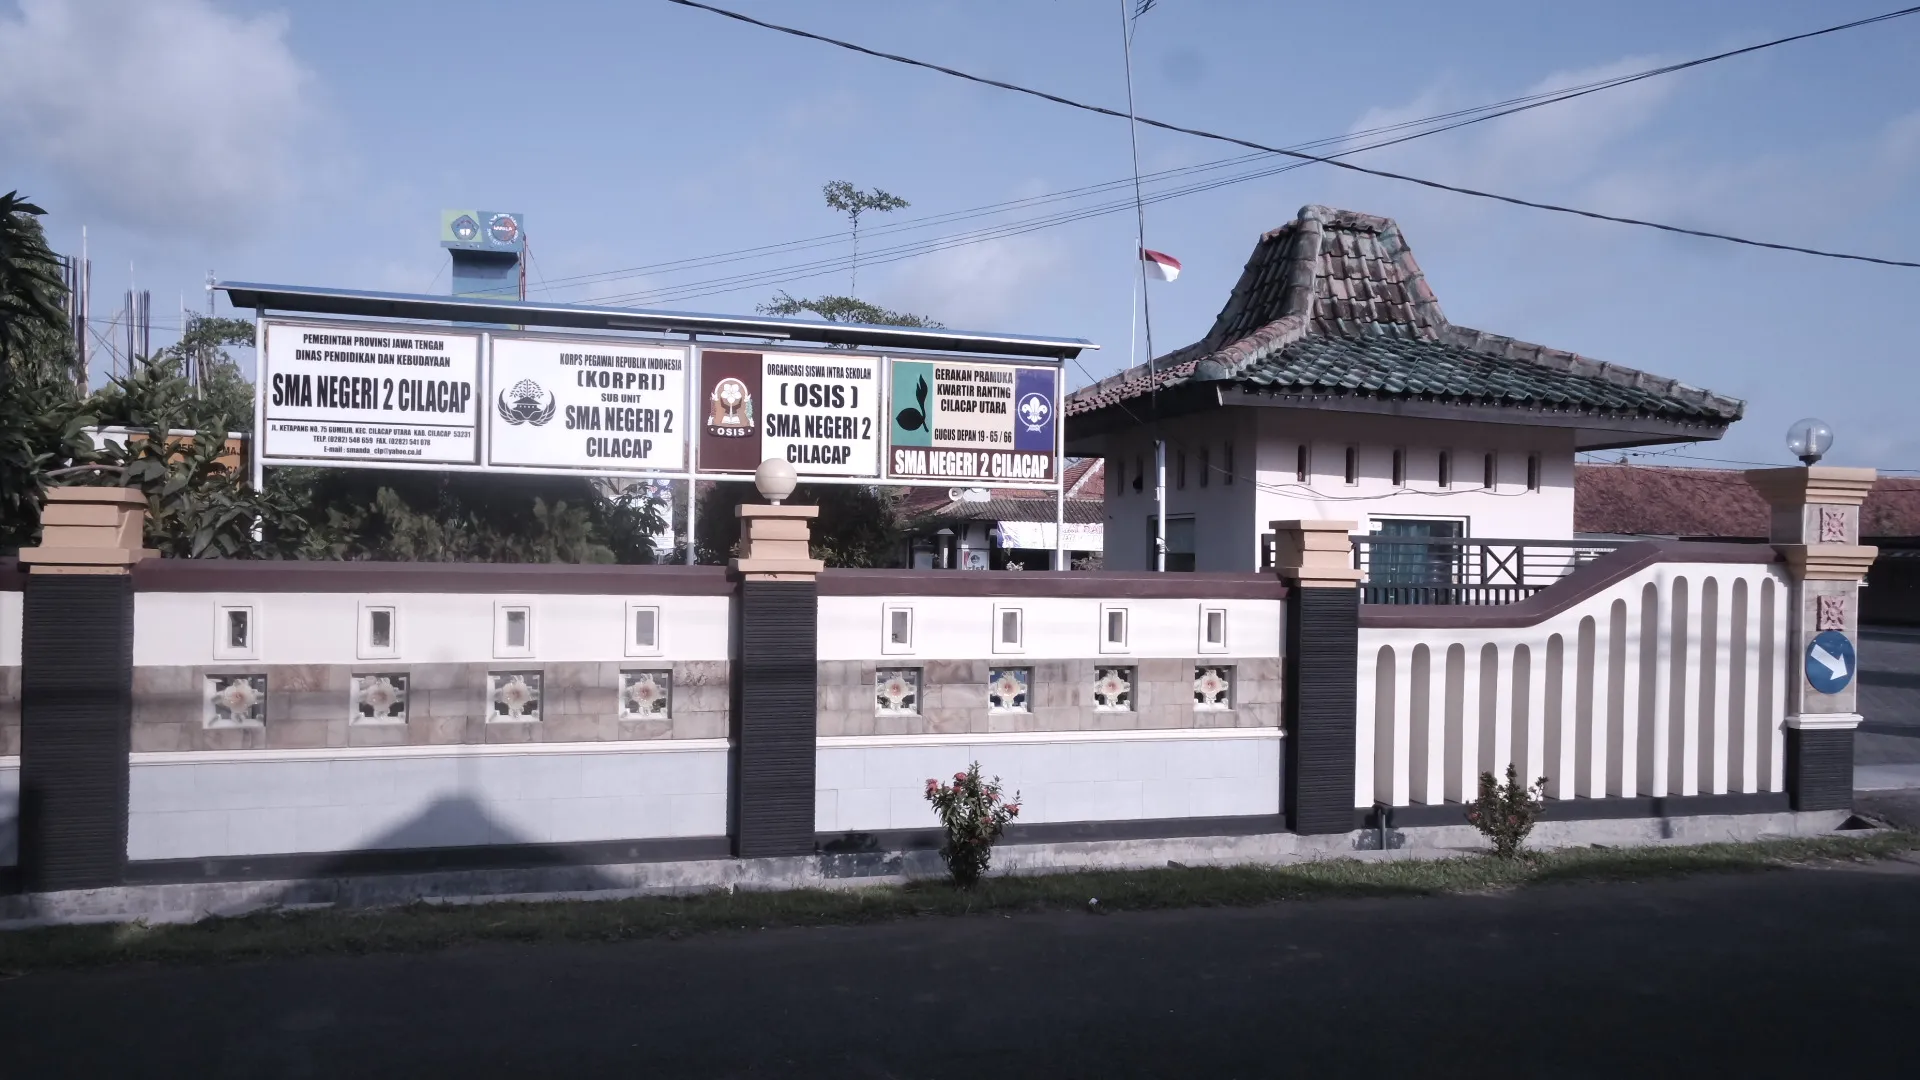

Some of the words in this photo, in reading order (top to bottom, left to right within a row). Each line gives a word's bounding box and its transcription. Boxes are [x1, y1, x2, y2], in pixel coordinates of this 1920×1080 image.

[303, 334, 352, 346] PEMERINTAH
[354, 337, 390, 347] PROVINSI
[392, 339, 413, 349] JAWA
[415, 340, 444, 350] TENGAH
[296, 350, 321, 361] DINAS
[324, 352, 375, 364] PENDIDIKAN
[378, 354, 395, 364] DAN
[397, 355, 450, 367] KEBUDAYAAN
[560, 353, 583, 365] KORPS
[585, 355, 614, 367] PEGAWAI
[616, 357, 646, 369] REPUBLIK
[648, 358, 681, 370] INDONESIA
[768, 364, 804, 376] ORGANISASI
[805, 366, 825, 378] SISWA
[827, 367, 844, 378] INTRA
[846, 368, 871, 379] SEKOLAH
[935, 369, 972, 382] GERAKAN
[974, 370, 1013, 383] PRAMUKA
[577, 370, 665, 391] (KORPRI)
[273, 373, 312, 407] SMA
[317, 376, 378, 409] NEGERI
[383, 378, 393, 410] 2
[399, 379, 470, 413] CILACAP
[601, 393, 619, 402] SUB
[621, 394, 641, 403] UNIT
[937, 384, 974, 397] KWARTIR
[977, 385, 1011, 398] RANTING
[941, 399, 977, 412] CILACAP
[979, 401, 1006, 414] UTARA
[565, 405, 600, 430] SMA
[605, 407, 659, 432] NEGERI
[664, 410, 673, 433] 2
[767, 414, 801, 437] SMA
[805, 415, 857, 439] NEGERI
[862, 417, 871, 440] 2
[717, 428, 744, 436] OSIS
[935, 429, 955, 441] GUGUS
[957, 430, 976, 441] DEPAN
[978, 430, 985, 442] 19
[990, 431, 998, 442] 65
[1004, 432, 1011, 443] 66
[586, 437, 652, 458] CILACAP
[787, 444, 851, 464] CILACAP
[895, 450, 926, 474] SMA
[930, 451, 977, 476] NEGERI
[980, 453, 989, 477] 2
[992, 454, 1048, 478] CILACAP
